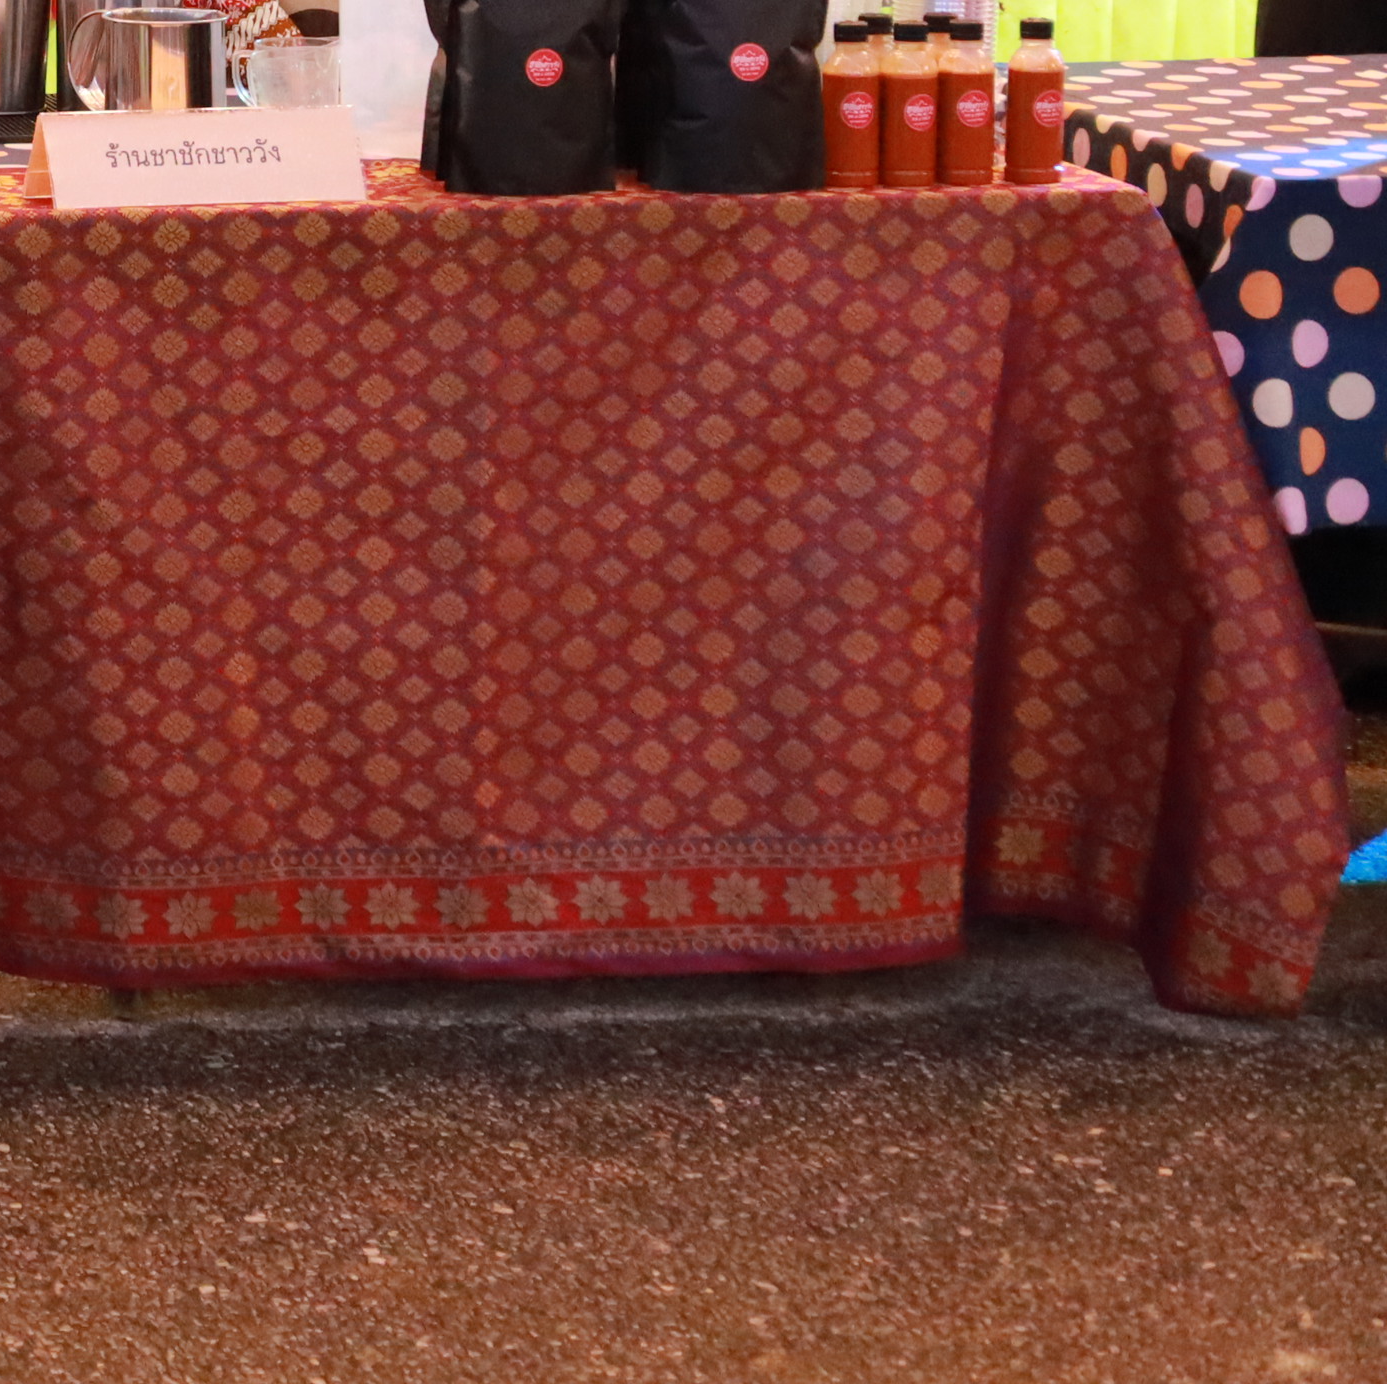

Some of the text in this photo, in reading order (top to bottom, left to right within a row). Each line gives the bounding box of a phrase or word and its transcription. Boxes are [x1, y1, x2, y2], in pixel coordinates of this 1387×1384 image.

[105, 138, 282, 168] ร้านชาชักชาววัง
